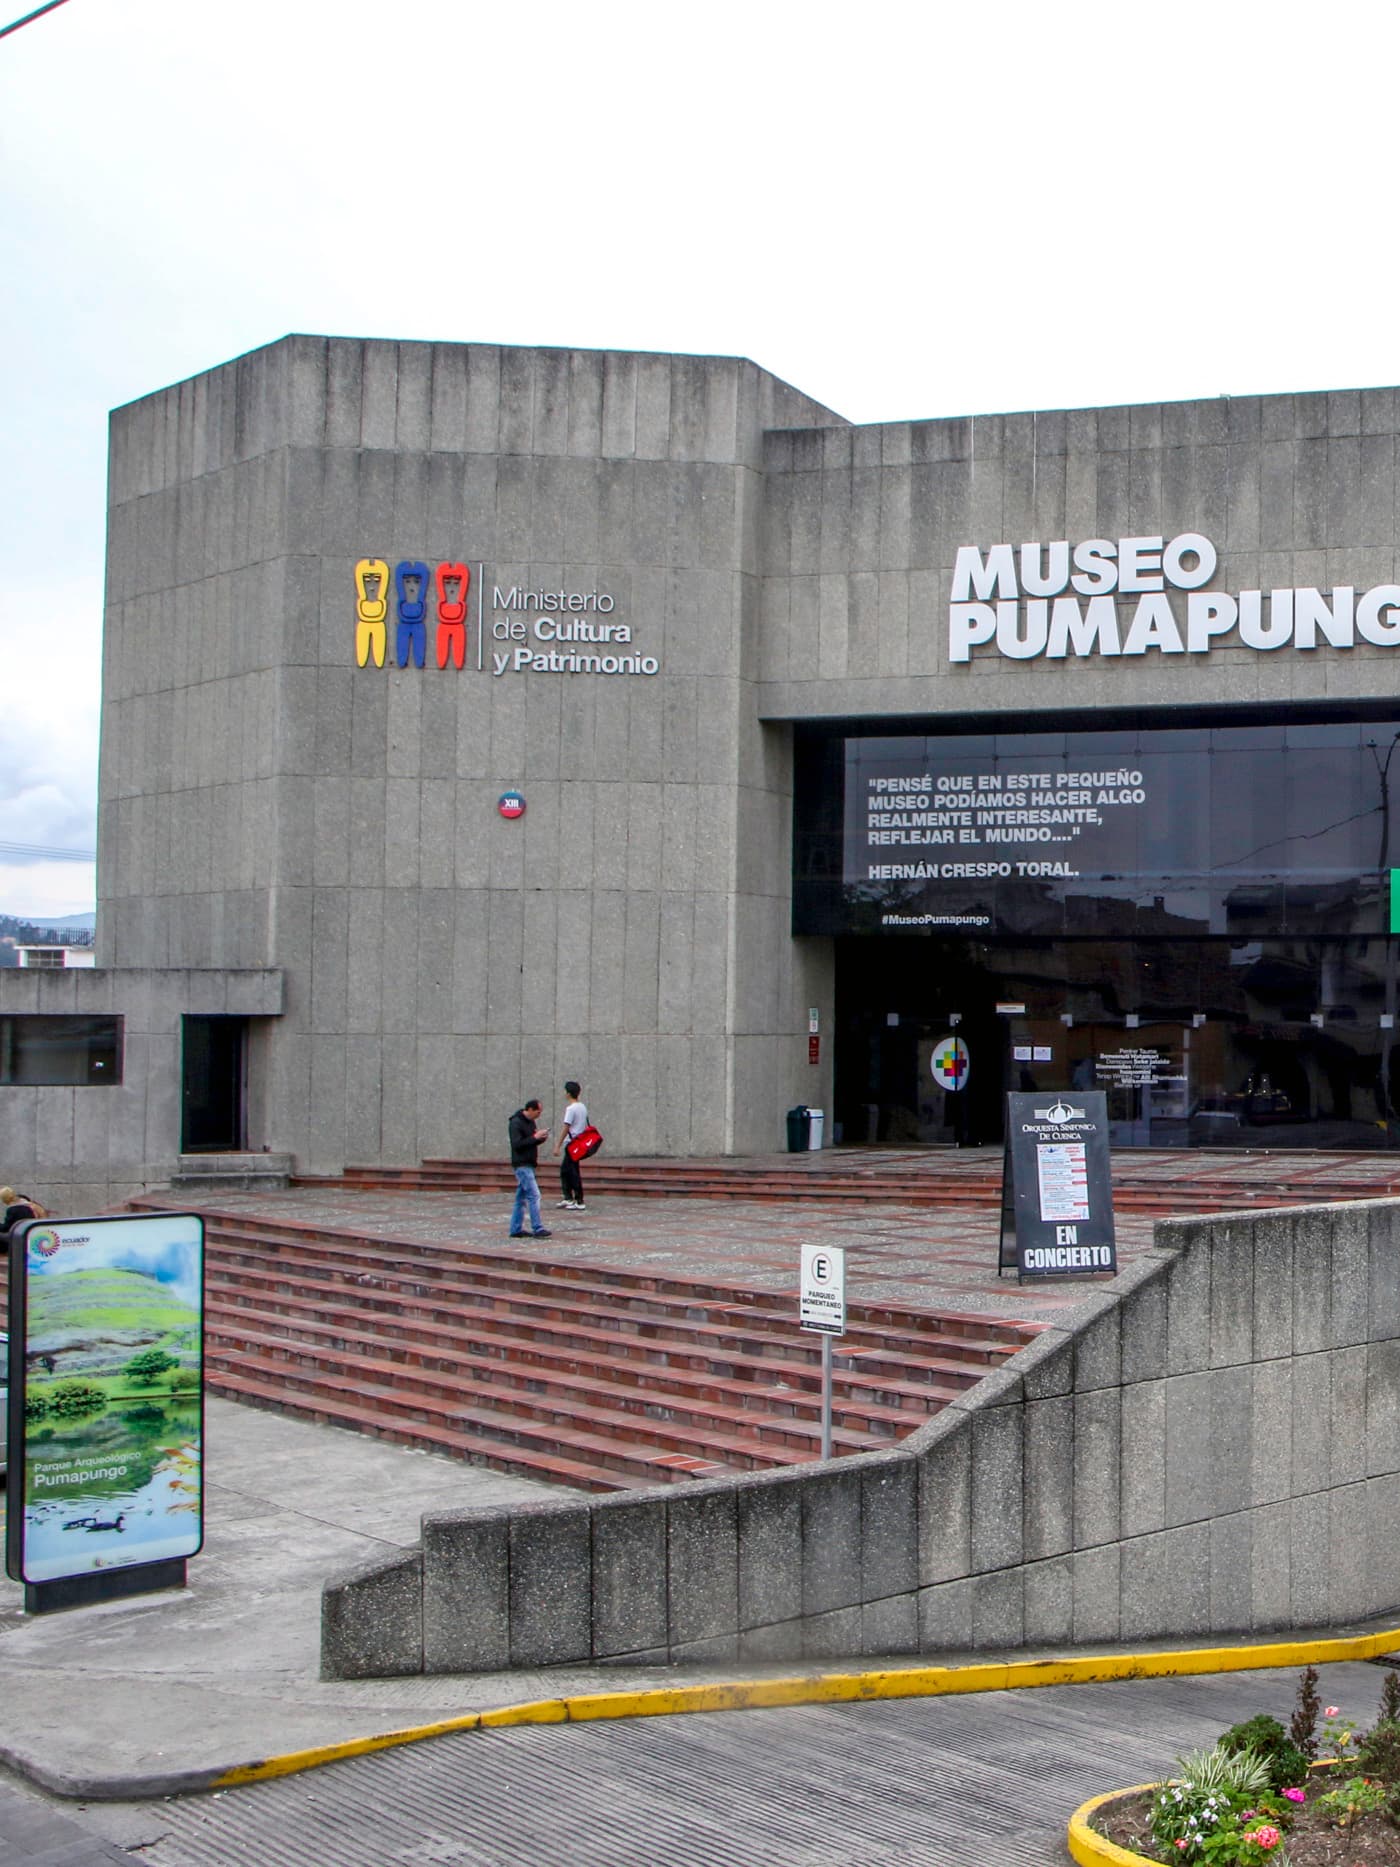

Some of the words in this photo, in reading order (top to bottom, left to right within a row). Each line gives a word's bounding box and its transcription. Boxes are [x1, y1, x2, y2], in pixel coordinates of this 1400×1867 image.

[949, 532, 1217, 601] MUSEO
[493, 586, 615, 613] Ministerio
[493, 617, 527, 641] de
[534, 617, 633, 643] Cultura
[493, 652, 510, 677] y
[514, 648, 660, 675] Patrimonio
[869, 774, 932, 792] "PENSÉ
[937, 776, 973, 791] QUE
[978, 775, 1002, 790] EN
[1006, 774, 1052, 789] ESTE
[1056, 769, 1143, 788] PEQUEÑO
[868, 795, 929, 810] MUSEO
[934, 790, 1026, 809] PODÍAMOS
[1031, 791, 1093, 806] HACER
[1096, 789, 1146, 804] ALGO
[868, 811, 972, 828] REALMENTE
[977, 808, 1103, 826] INTERESANTE,
[868, 829, 954, 845] REFLEJAR
[959, 829, 981, 843] EL
[868, 861, 938, 879] HERNÁN
[941, 862, 1011, 878] CRESPO
[1016, 861, 1080, 877] TORAL.
[882, 914, 989, 927] #MuseoPumapungo
[1022, 1124, 1060, 1133] ORQUESTA
[1060, 1123, 1097, 1132] SINFONICA
[1052, 1132, 1082, 1140] CUENCA
[1056, 1226, 1078, 1245] EN
[1024, 1246, 1111, 1269] CONCIERTO
[817, 1259, 827, 1279] E
[802, 1298, 842, 1310] MOMENTANEO
[808, 1290, 836, 1301] PARQUEO
[34, 1461, 72, 1473] Parque
[74, 1451, 142, 1467] Arqueológico
[34, 1465, 128, 1488] Pumapungo
